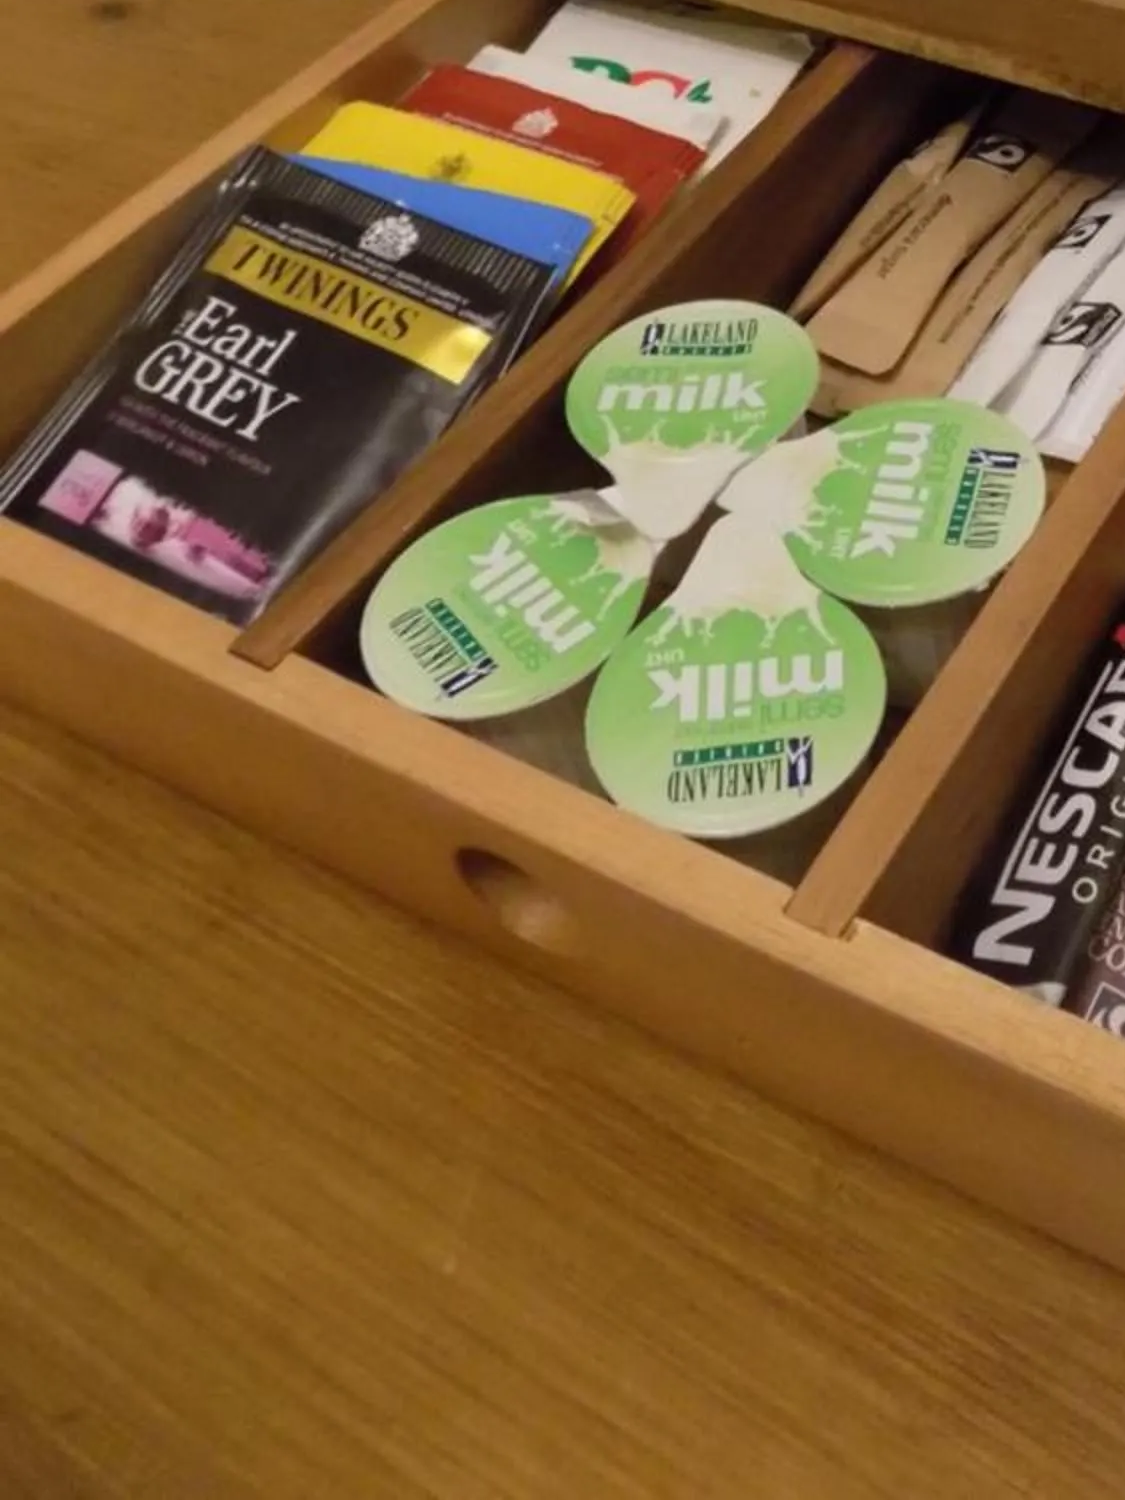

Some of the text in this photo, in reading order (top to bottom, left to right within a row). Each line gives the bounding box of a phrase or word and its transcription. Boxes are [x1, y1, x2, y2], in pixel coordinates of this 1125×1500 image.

[232, 243, 421, 341] TWININGS
[667, 317, 759, 345] LAKELAND
[181, 294, 299, 377] Earl
[134, 338, 302, 442] GREY
[597, 371, 769, 413] milk
[848, 420, 935, 559] milk
[467, 530, 597, 654] milk
[647, 649, 844, 723] milk
[667, 757, 783, 805] LAKELAND
